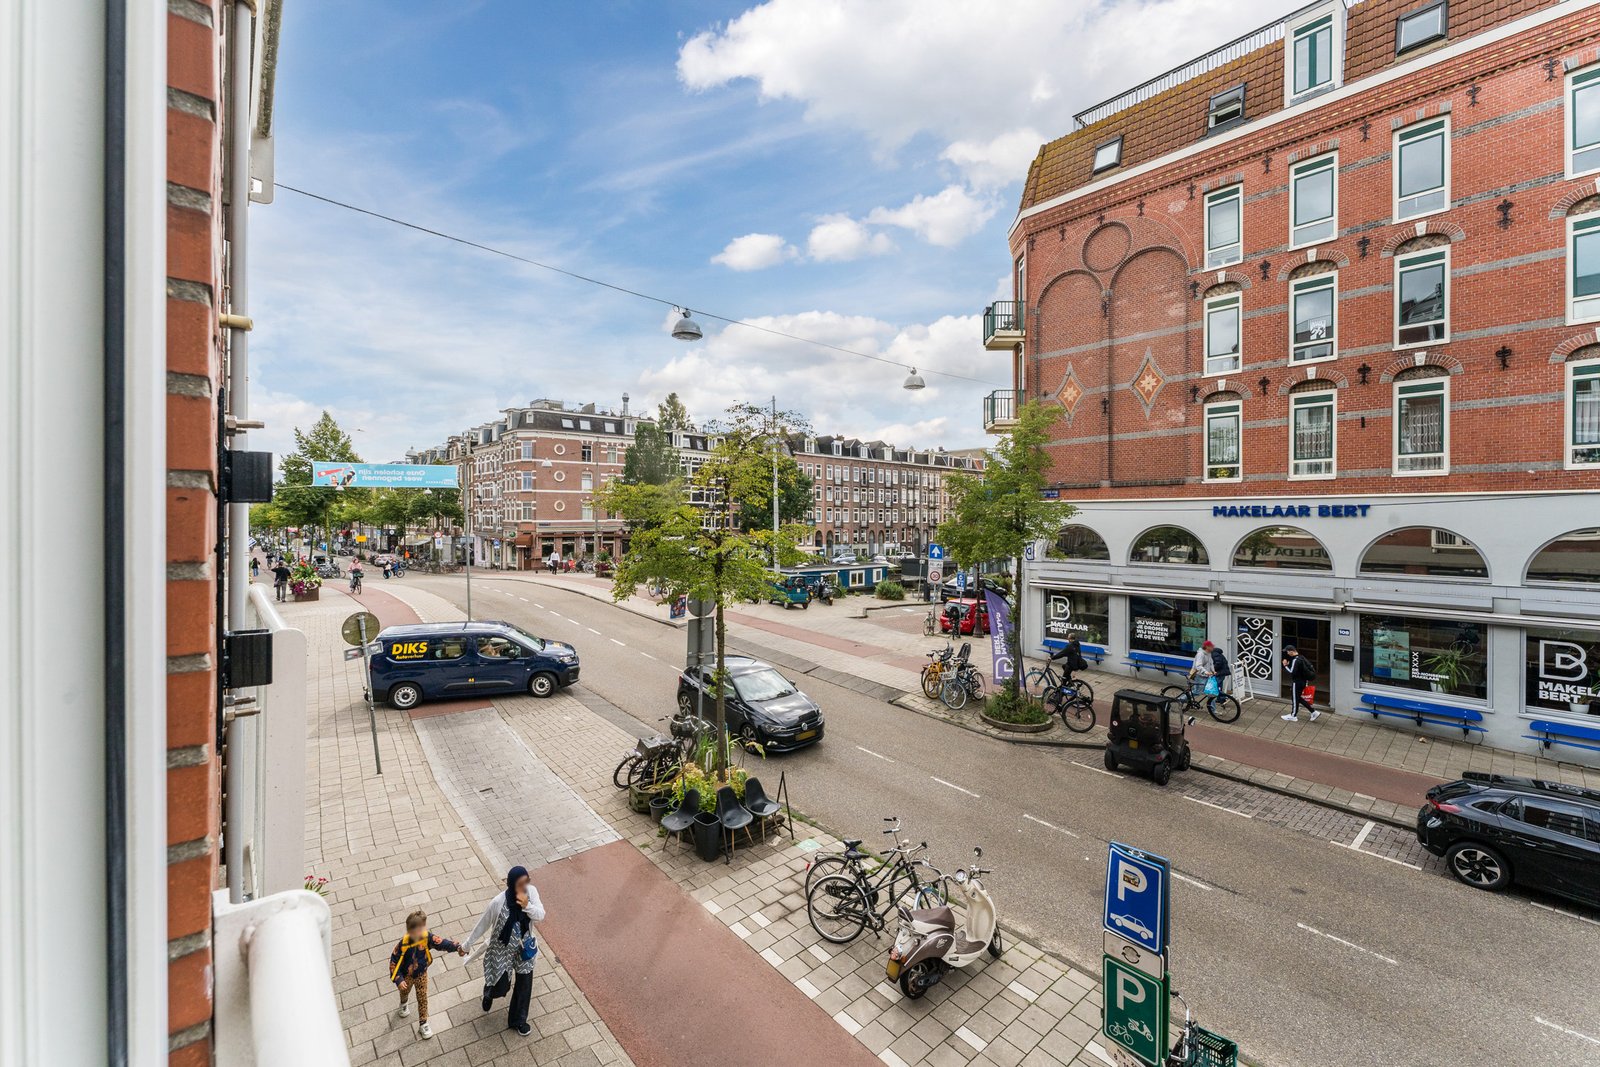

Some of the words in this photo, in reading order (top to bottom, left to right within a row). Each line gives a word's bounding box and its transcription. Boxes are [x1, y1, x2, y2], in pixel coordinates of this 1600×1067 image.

[1212, 505, 1311, 518] MAKELAAR
[1318, 504, 1371, 518] BERT
[1050, 621, 1089, 632] MAKELAAR
[392, 642, 428, 655] DIKS
[1539, 681, 1600, 698] MAKEL
[1539, 690, 1581, 704] BERT
[1117, 859, 1148, 901] P
[1116, 968, 1146, 1010] P
